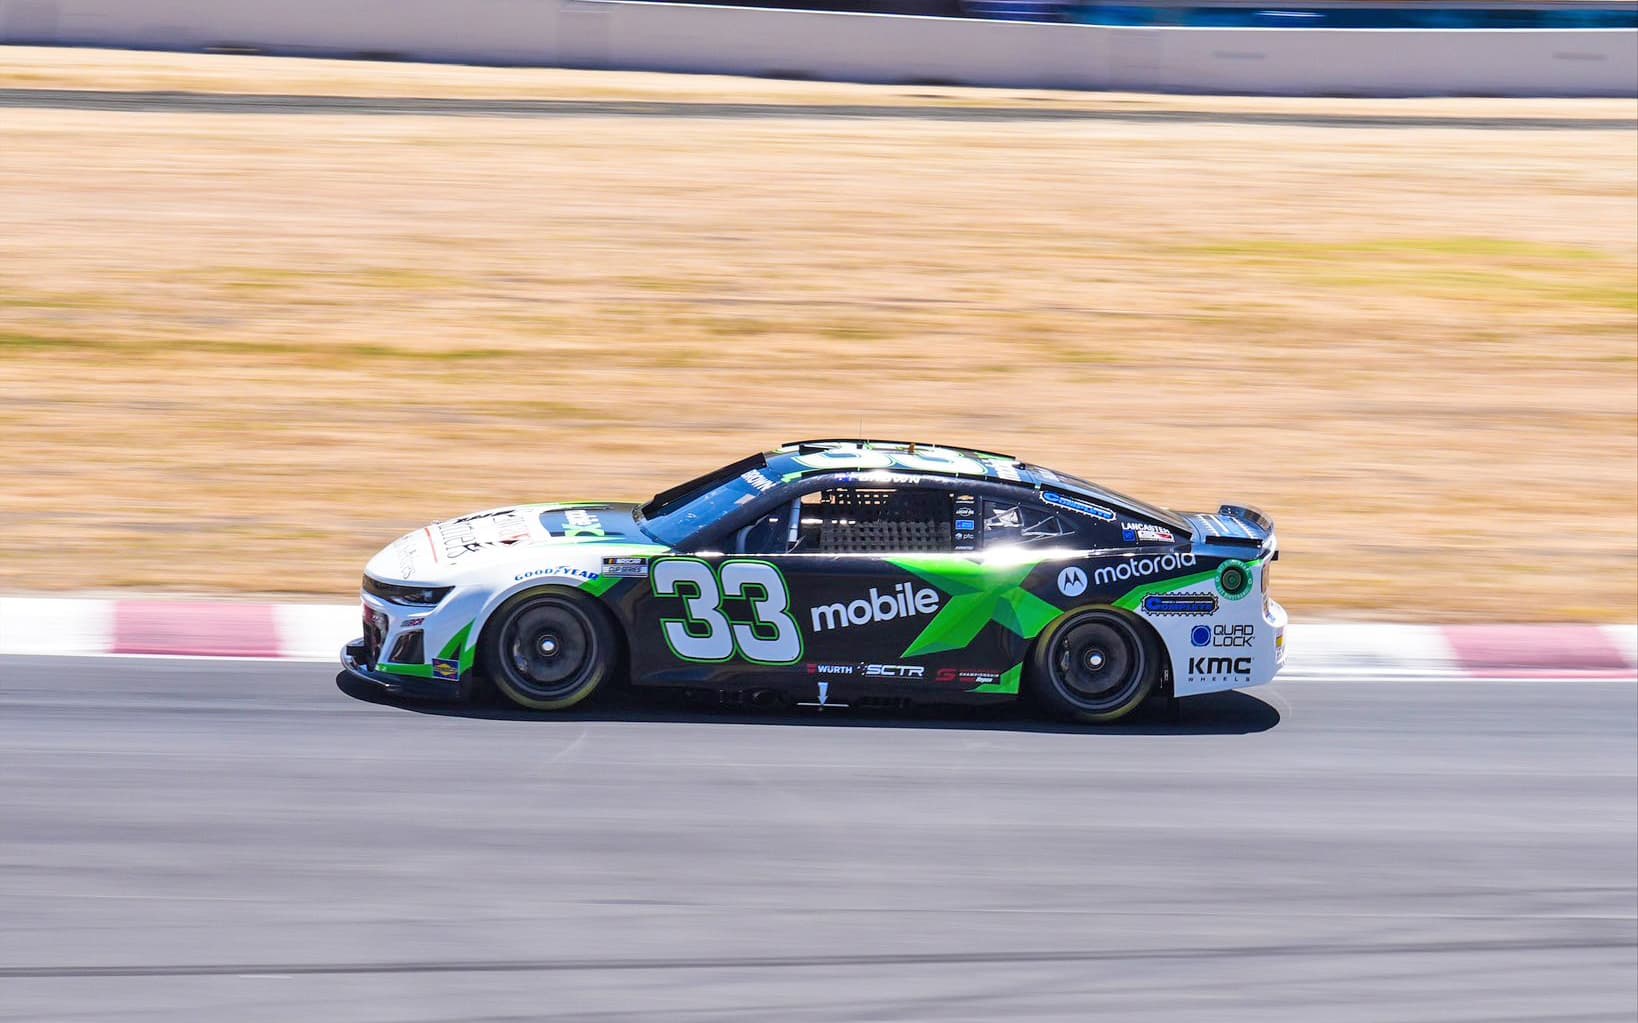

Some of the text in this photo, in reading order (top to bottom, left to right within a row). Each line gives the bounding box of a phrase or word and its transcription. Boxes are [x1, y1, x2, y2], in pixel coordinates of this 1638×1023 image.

[1094, 552, 1197, 585] motorola
[650, 556, 805, 667] 33
[811, 582, 939, 632] mobile
[1213, 624, 1254, 636] QUAD
[1213, 636, 1253, 647] LOCK
[866, 664, 925, 677] SCTR
[1188, 657, 1252, 675] KMC
